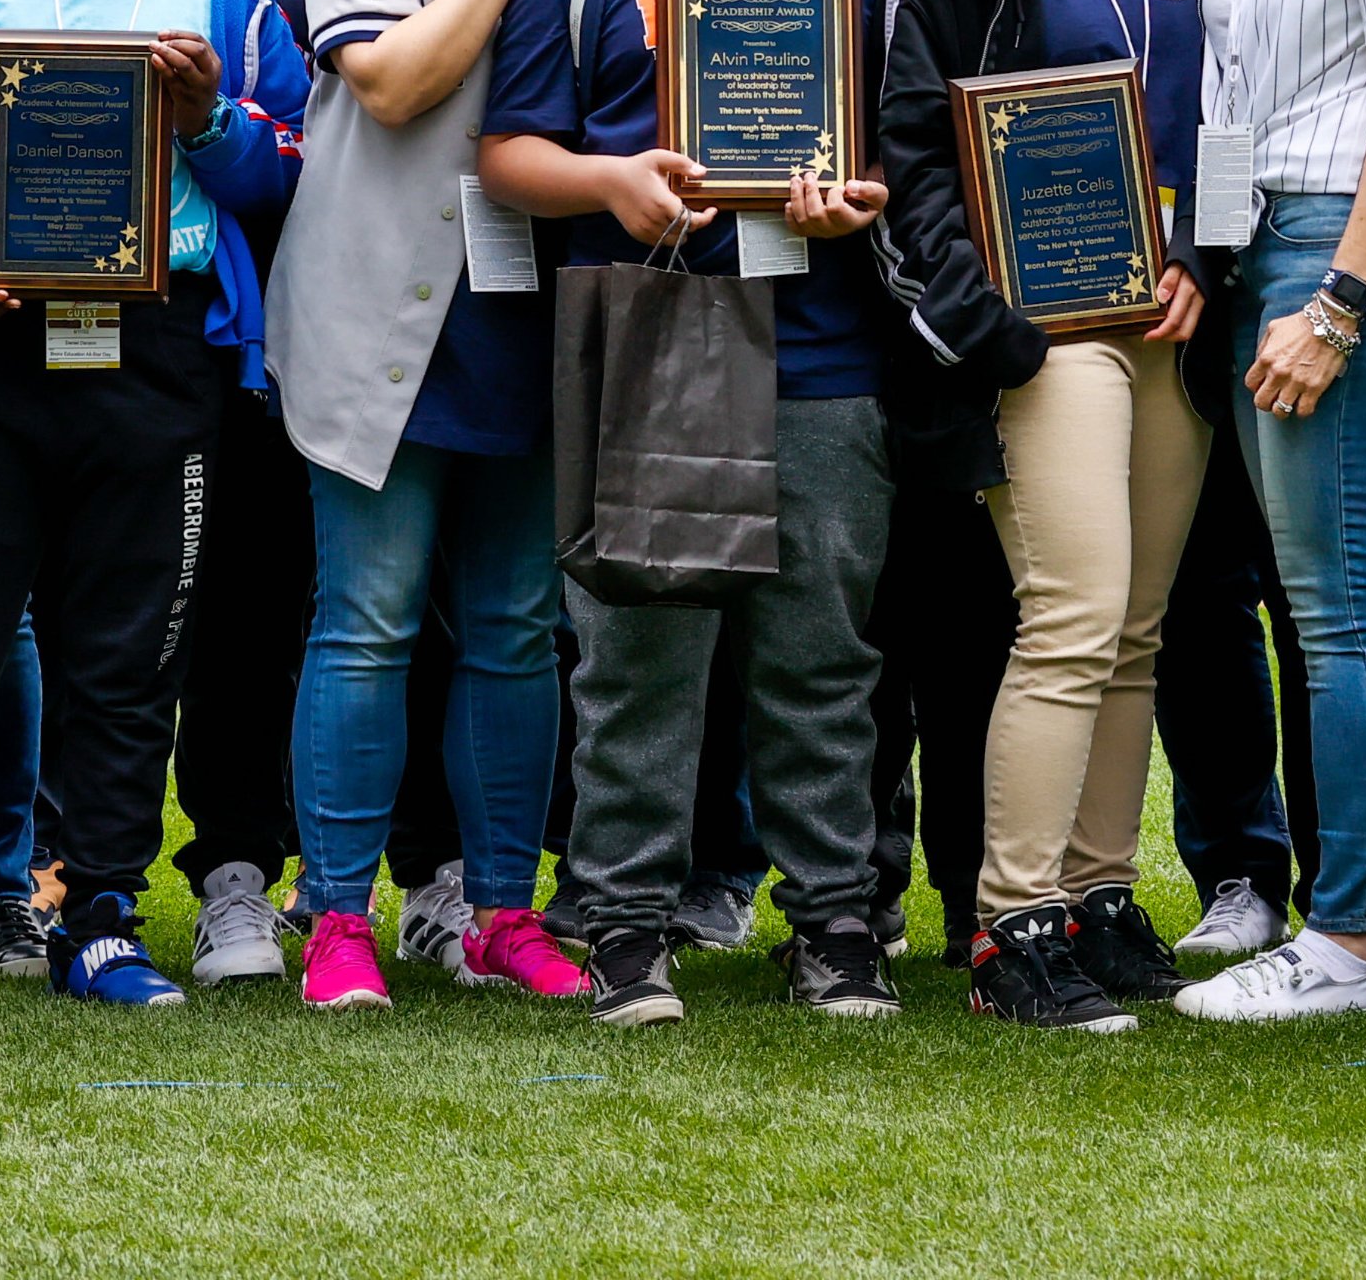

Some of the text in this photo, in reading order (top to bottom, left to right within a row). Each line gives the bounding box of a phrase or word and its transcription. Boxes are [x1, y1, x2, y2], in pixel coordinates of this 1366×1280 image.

[710, 6, 815, 16] LEADERSHIP AWARD
[709, 51, 810, 66] Alvin Paulino
[703, 71, 716, 80] For
[717, 71, 741, 82] being
[749, 72, 778, 81] shining
[778, 72, 815, 81] example
[726, 81, 791, 91] of leadership for
[718, 90, 753, 99] students
[753, 90, 761, 99] in
[762, 91, 776, 99] the
[777, 90, 800, 99] Bronx
[17, 98, 129, 108] Academic Achievement Award
[718, 106, 733, 114] The
[770, 107, 802, 115] Yankees
[757, 115, 764, 123] &
[702, 123, 725, 131] Bronx
[726, 123, 759, 133] Borough
[759, 123, 794, 132] Citywide
[742, 131, 779, 141] May 2022
[1007, 125, 1115, 145] COMMUNITY SERVICE AWARD
[16, 143, 122, 159] Daniel Danson
[1020, 176, 1114, 201] Juzette Celis
[1023, 198, 1118, 217] In recognition of your
[66, 309, 98, 318] GUEST
[178, 453, 204, 591] ABERCROMBIE
[81, 937, 138, 980] NIKE
